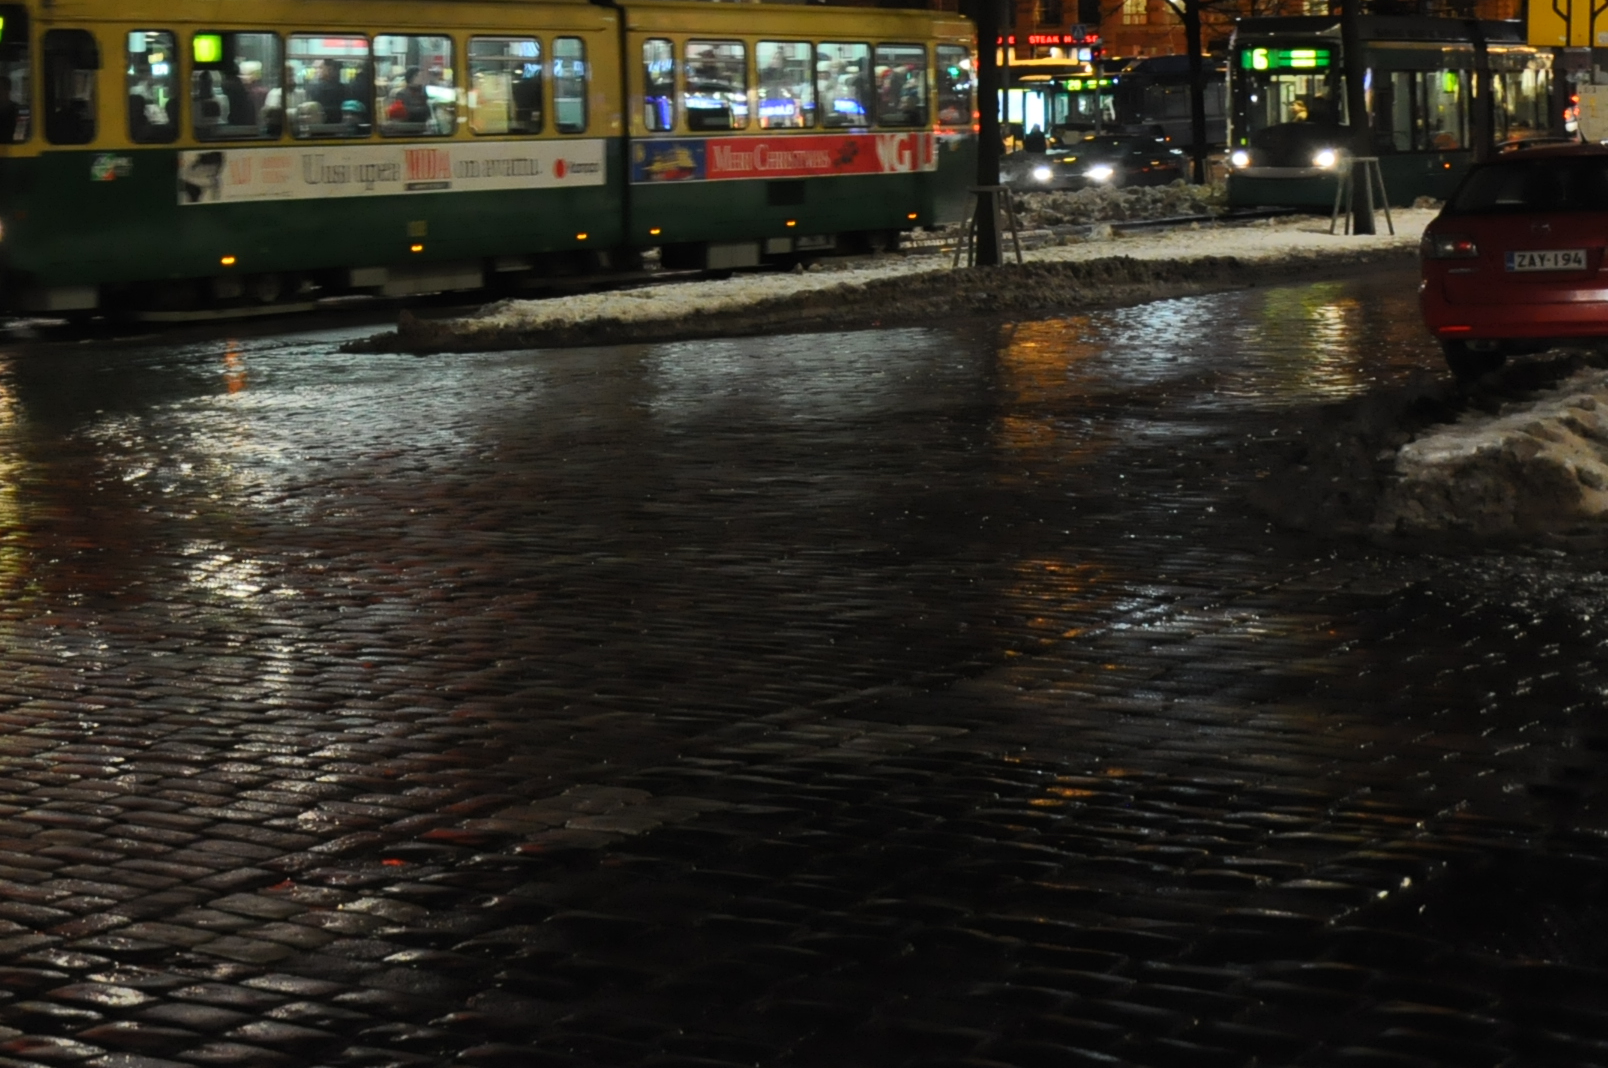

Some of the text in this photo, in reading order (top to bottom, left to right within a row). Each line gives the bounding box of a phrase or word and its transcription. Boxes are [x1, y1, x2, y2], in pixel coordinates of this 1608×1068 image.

[1029, 35, 1099, 45] STEAK HSE
[1252, 48, 1269, 70] 6
[1516, 252, 1583, 268] ZAY-194
